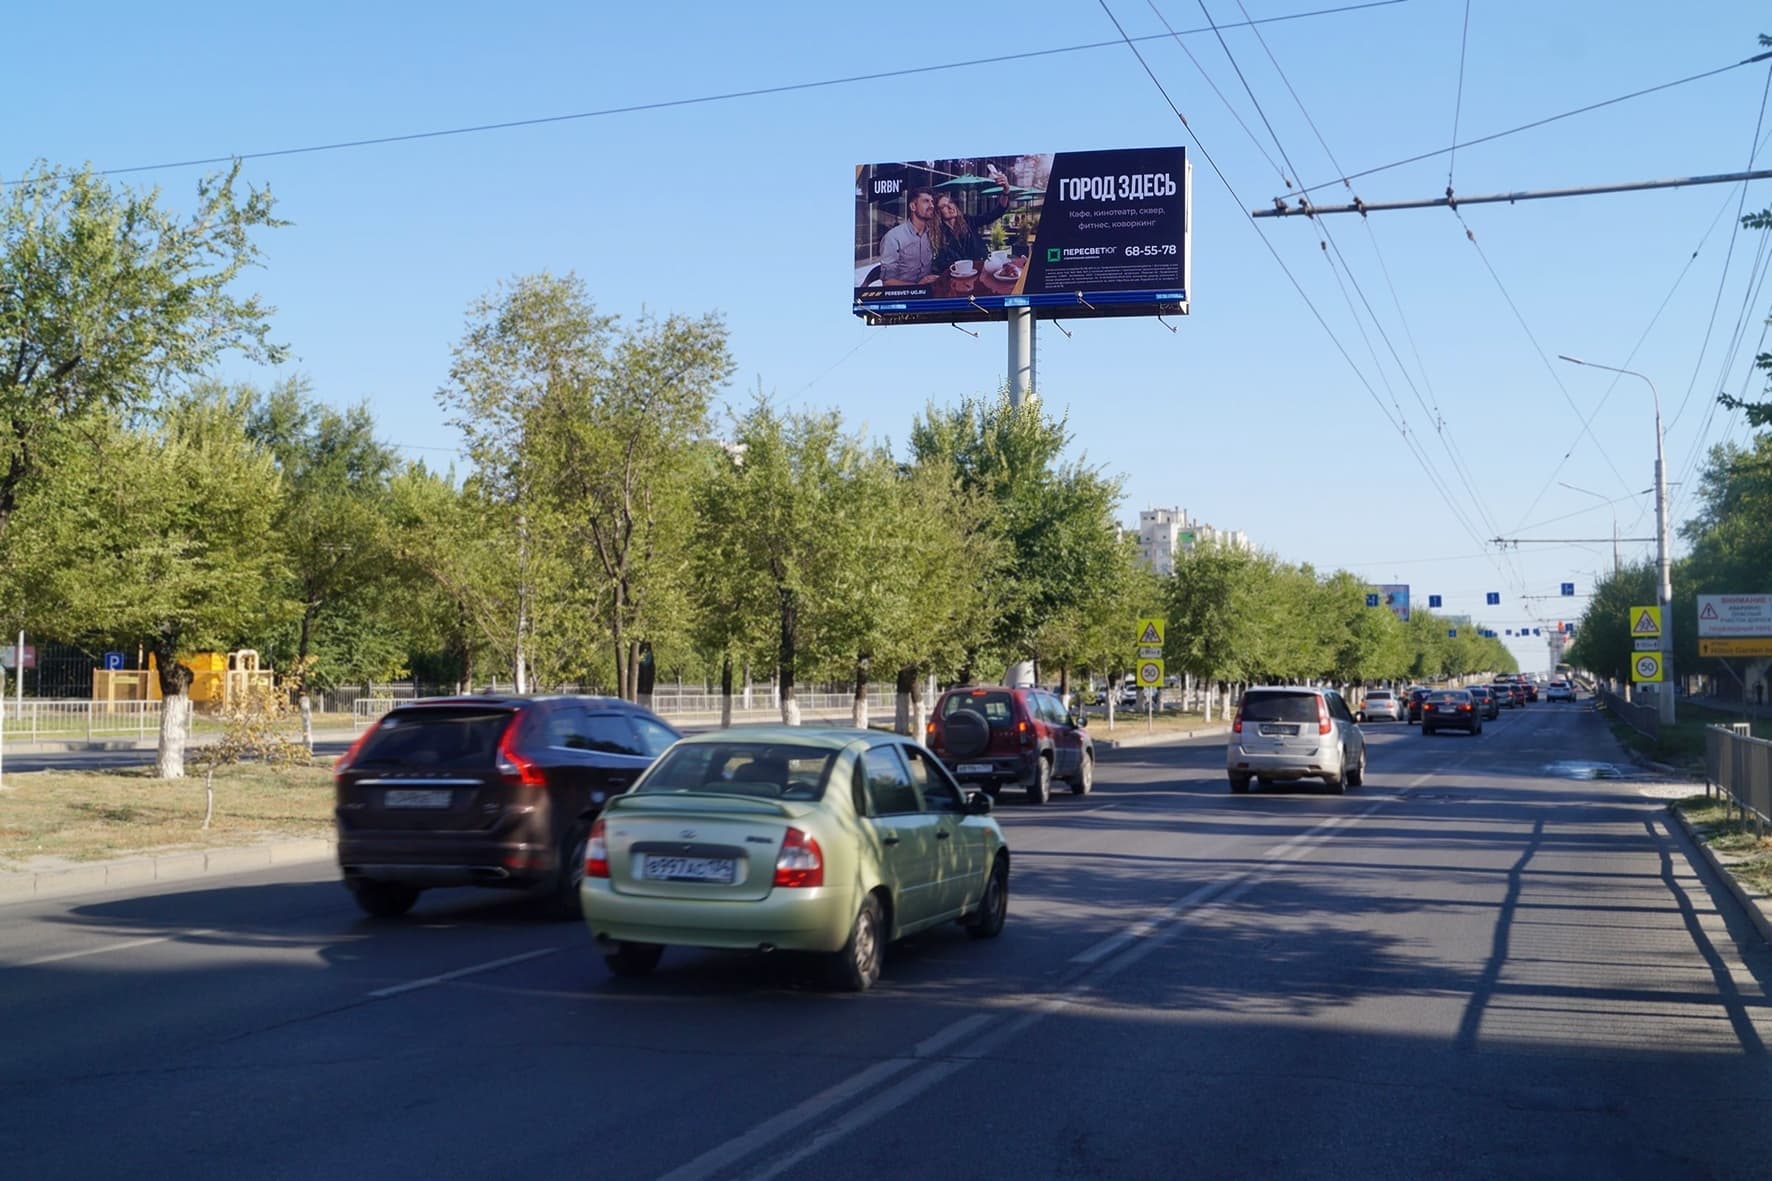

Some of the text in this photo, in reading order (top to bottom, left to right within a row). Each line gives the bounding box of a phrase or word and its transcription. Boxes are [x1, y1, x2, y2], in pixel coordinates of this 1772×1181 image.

[1059, 173, 1177, 201] ГОРОД ЗДЕСЬ
[1069, 207, 1166, 219] Кафе, кинотеатр, сквер,
[1078, 220, 1156, 231] фитнес, коворкинг
[1124, 244, 1177, 256] 68-55-78
[110, 655, 120, 669] P
[1641, 662, 1654, 671] 50
[1144, 668, 1156, 677] 50
